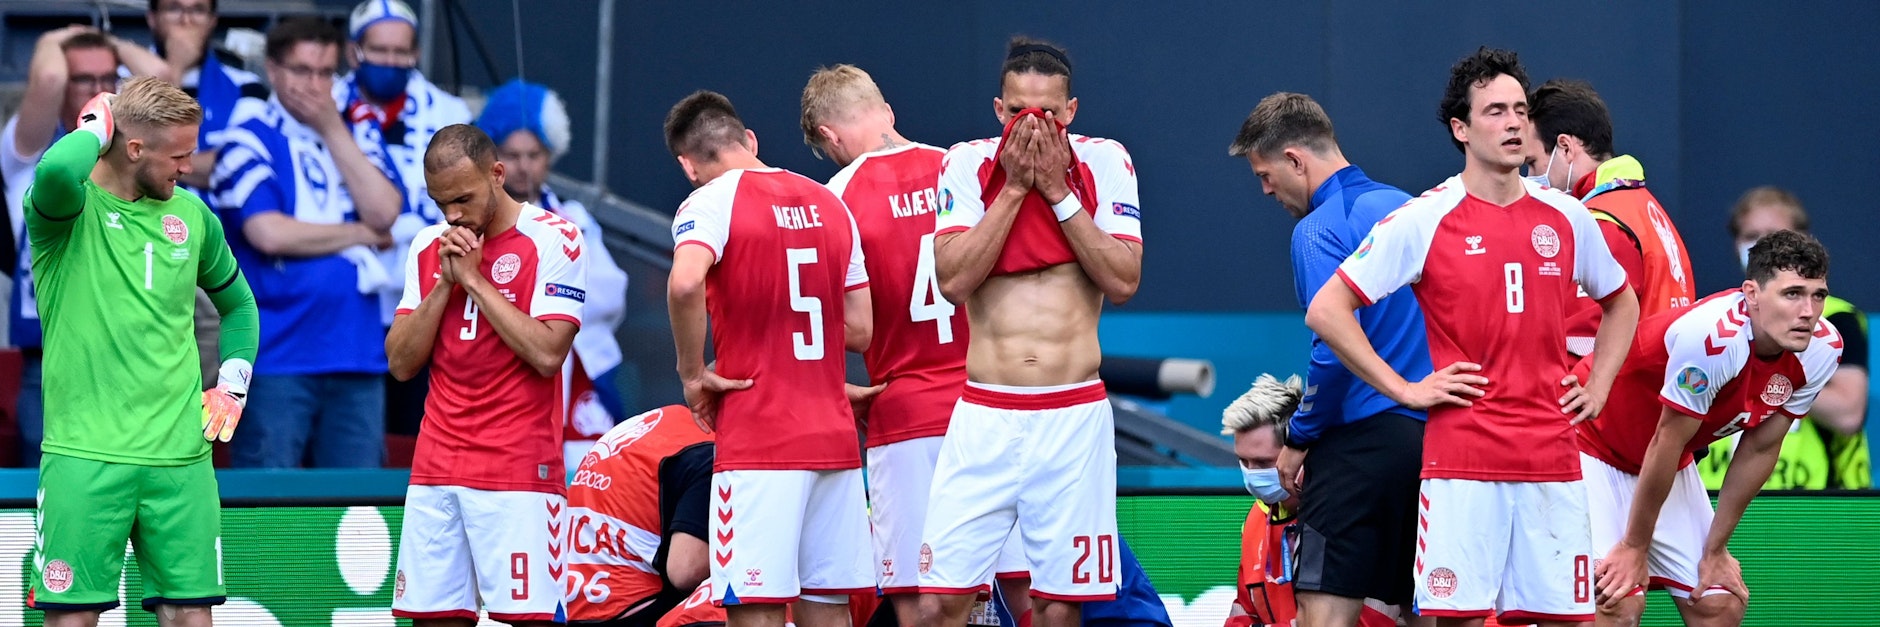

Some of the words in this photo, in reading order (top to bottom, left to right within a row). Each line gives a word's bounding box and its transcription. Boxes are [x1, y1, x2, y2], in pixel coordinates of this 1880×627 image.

[888, 187, 937, 218] KJÆR
[143, 241, 153, 289] 1
[909, 231, 956, 345] 4
[1504, 262, 1524, 313] 8
[459, 291, 479, 341] 9
[556, 286, 585, 301] RESPECT
[786, 247, 825, 361] 5
[1766, 384, 1786, 395] DBU
[49, 570, 68, 581] DBU
[214, 536, 224, 586] 1
[510, 552, 529, 600] 9
[1072, 534, 1114, 585] 20
[1433, 577, 1452, 588] DBU
[1574, 554, 1590, 604] 8
